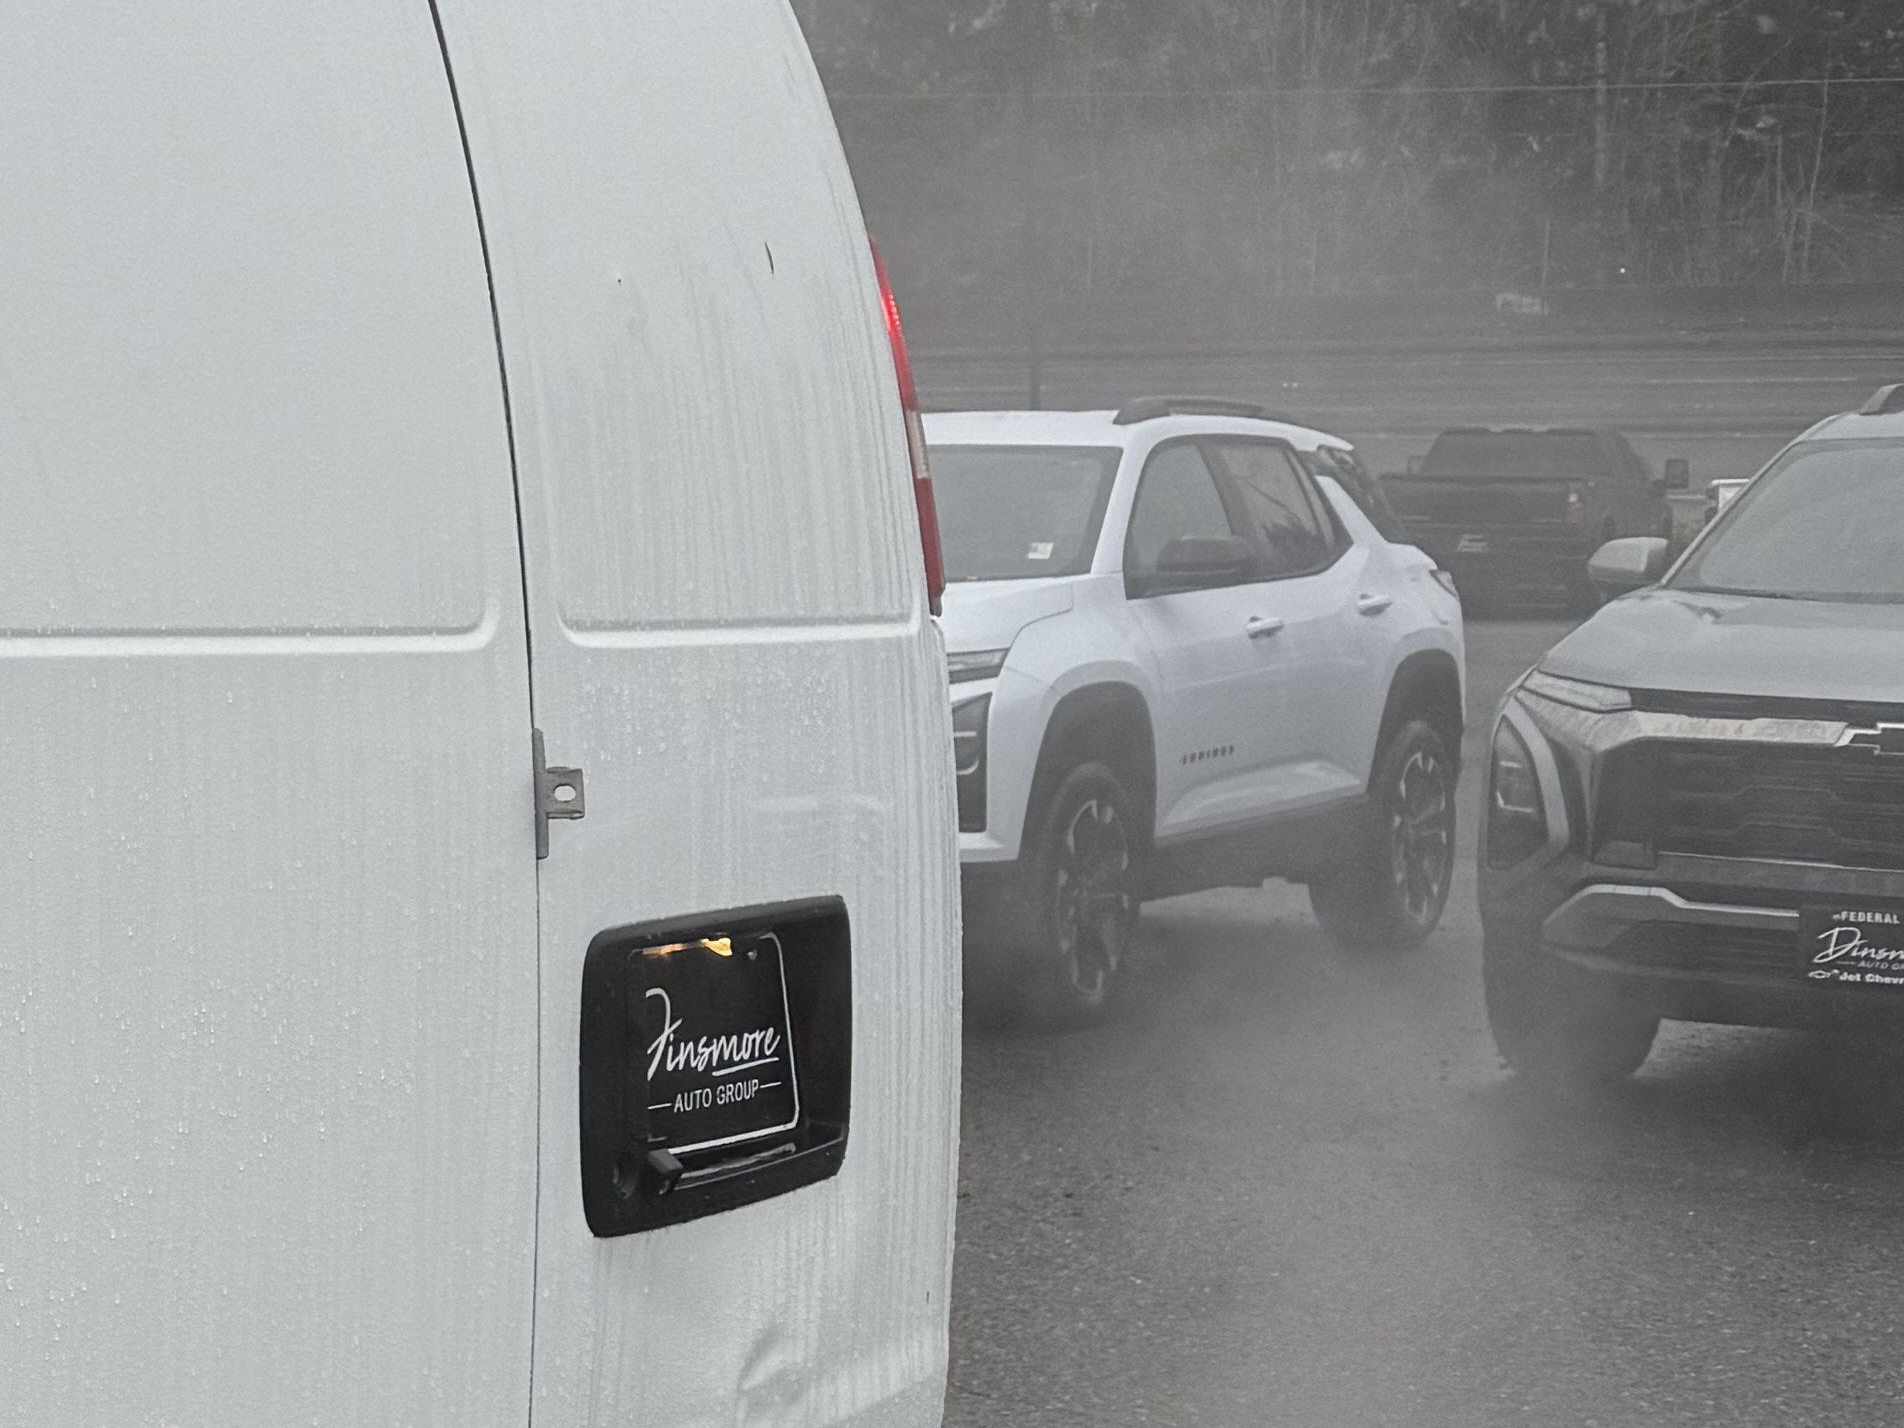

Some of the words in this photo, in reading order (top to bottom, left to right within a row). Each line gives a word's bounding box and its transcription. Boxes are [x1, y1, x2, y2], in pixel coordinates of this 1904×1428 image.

[1841, 910, 1900, 924] FEDERAL
[1857, 960, 1889, 969] AUTO
[674, 1088, 712, 1113] AUTO
[716, 1079, 759, 1105] GROUP
